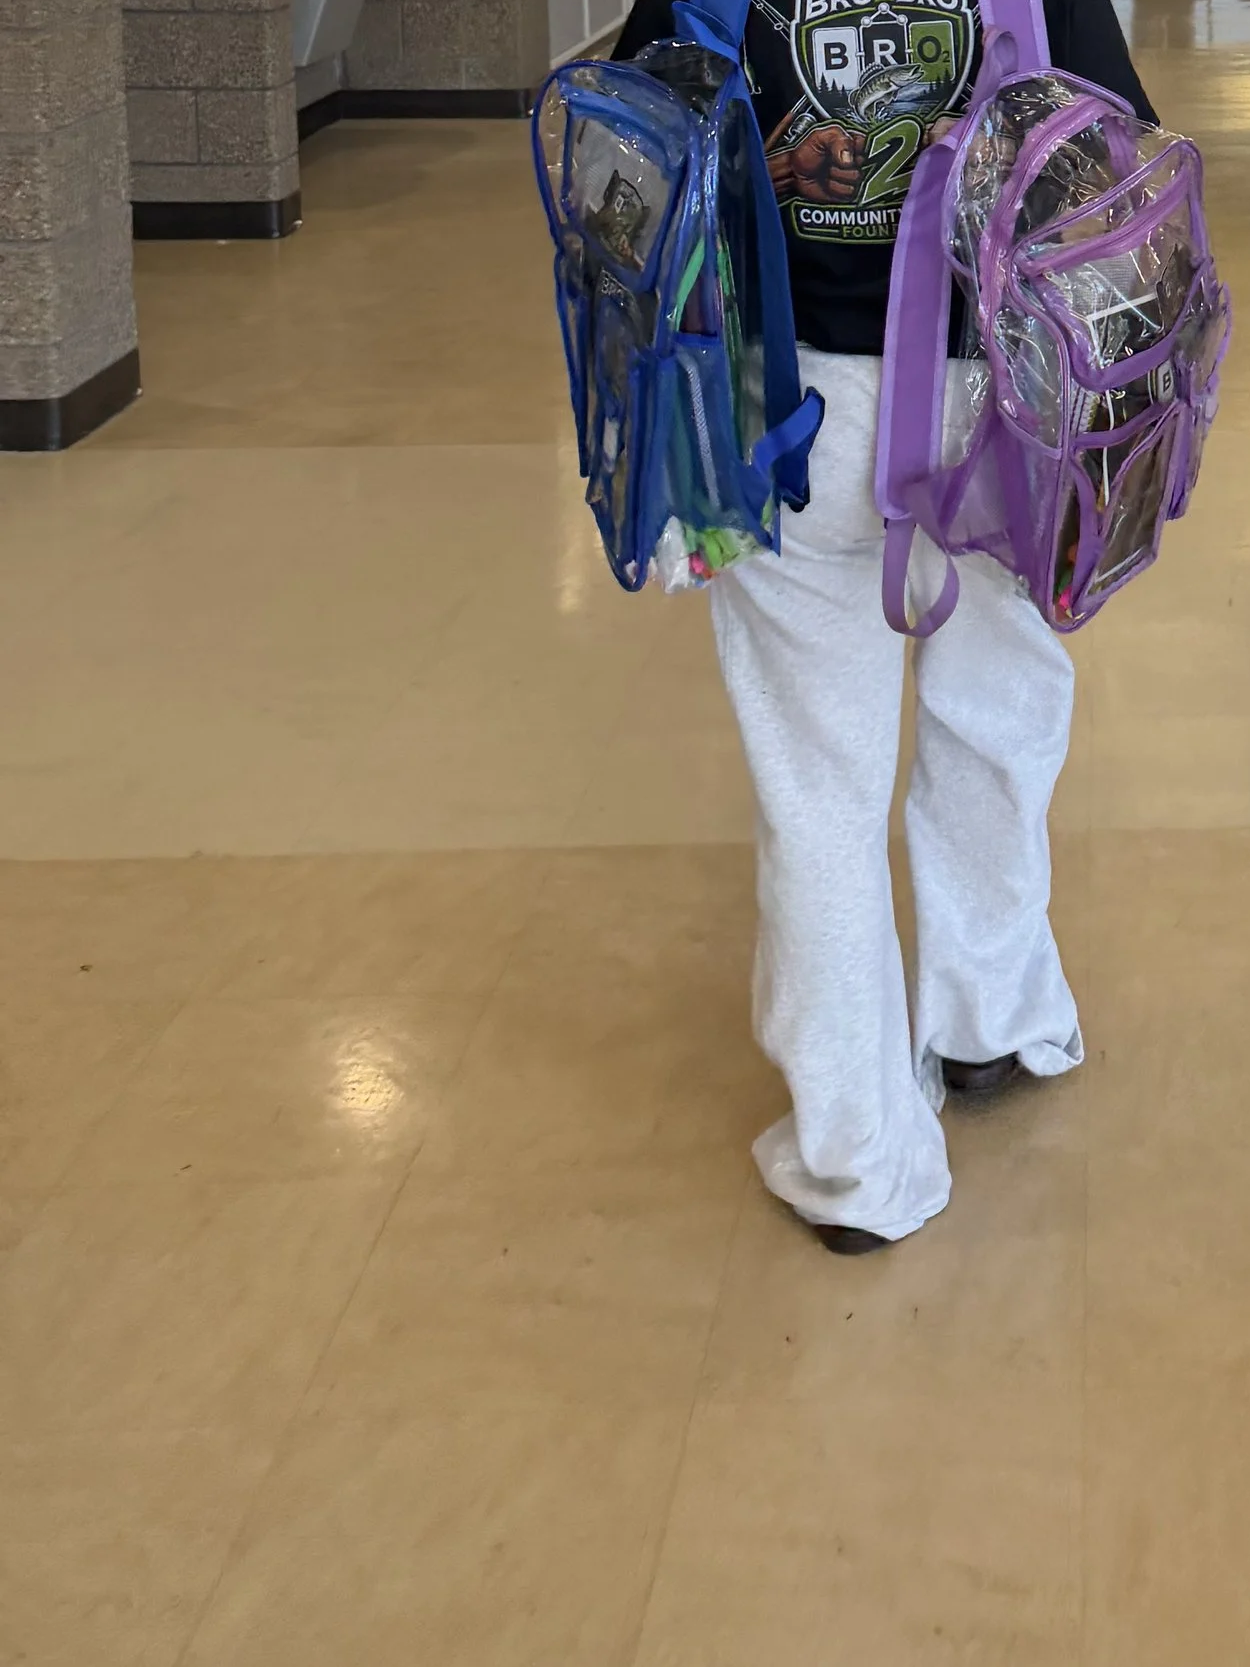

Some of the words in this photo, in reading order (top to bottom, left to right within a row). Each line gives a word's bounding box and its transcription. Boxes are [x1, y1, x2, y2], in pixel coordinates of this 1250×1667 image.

[823, 41, 850, 71] B
[872, 38, 897, 66] R
[860, 118, 921, 207] 2
[799, 207, 903, 226] COMMUNIT
